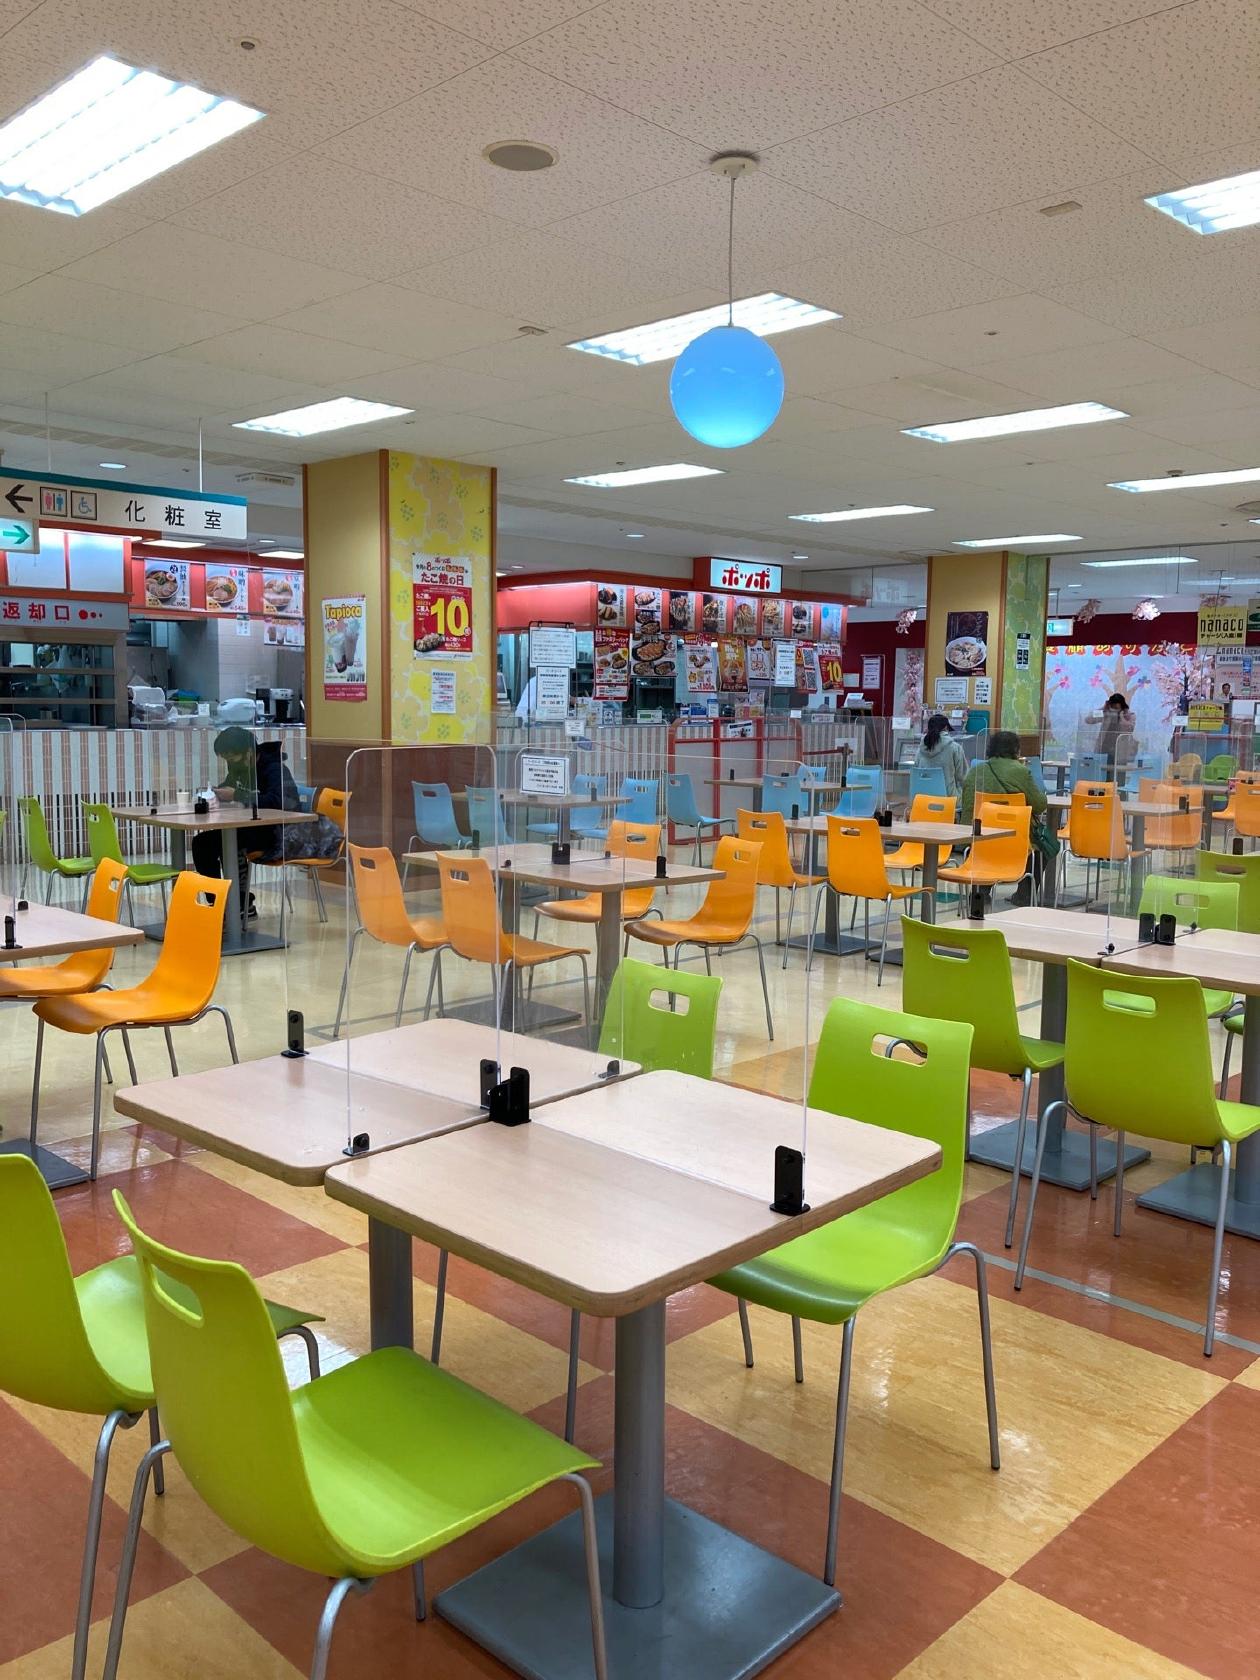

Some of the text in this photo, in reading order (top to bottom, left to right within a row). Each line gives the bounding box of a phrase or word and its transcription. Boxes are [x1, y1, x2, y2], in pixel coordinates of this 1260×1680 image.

[125, 499, 222, 530] 化粧室
[722, 563, 770, 590] ポッポ
[3, 602, 70, 621] 返却口
[325, 604, 362, 620] Tapioca
[430, 597, 469, 637] 10
[1200, 618, 1244, 633] nanaco
[826, 660, 843, 682] 10
